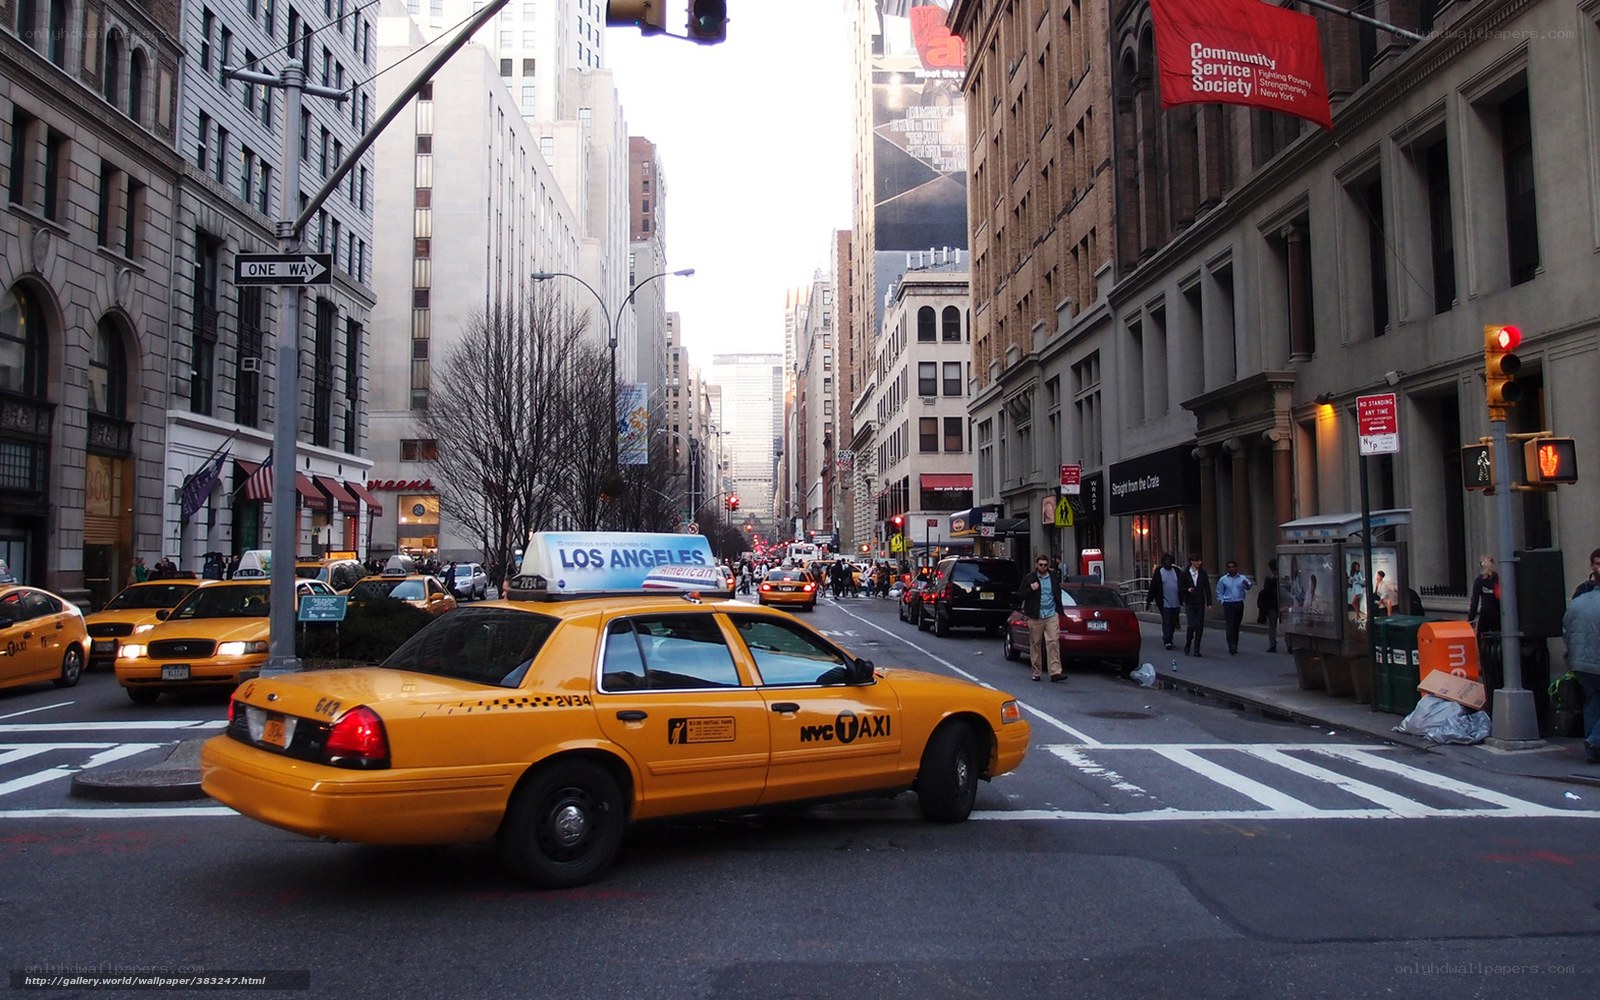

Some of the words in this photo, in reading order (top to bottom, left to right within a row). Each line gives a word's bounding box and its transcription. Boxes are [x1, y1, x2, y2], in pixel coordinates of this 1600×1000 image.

[1190, 42, 1276, 70] Community
[1191, 59, 1251, 77] Service
[1192, 75, 1252, 97] Society
[1258, 69, 1287, 82] Fighting
[1288, 74, 1312, 89] Poverty
[1260, 78, 1308, 96] Strengthening
[1260, 88, 1278, 99] New
[1279, 91, 1294, 102] York
[248, 263, 276, 276] ONE
[288, 263, 317, 276] WAY
[1369, 399, 1392, 407] STANDING
[1112, 482, 1128, 497] Straight
[1128, 480, 1138, 492] from
[1147, 475, 1159, 488] Crate
[559, 548, 604, 568] LOS
[610, 549, 706, 568] ANGELES
[659, 566, 713, 579] American
[1448, 644, 1468, 679] me
[315, 698, 341, 717] 643
[554, 695, 592, 707] 2V34
[800, 725, 833, 742] NYC
[837, 713, 890, 740] TAXI
